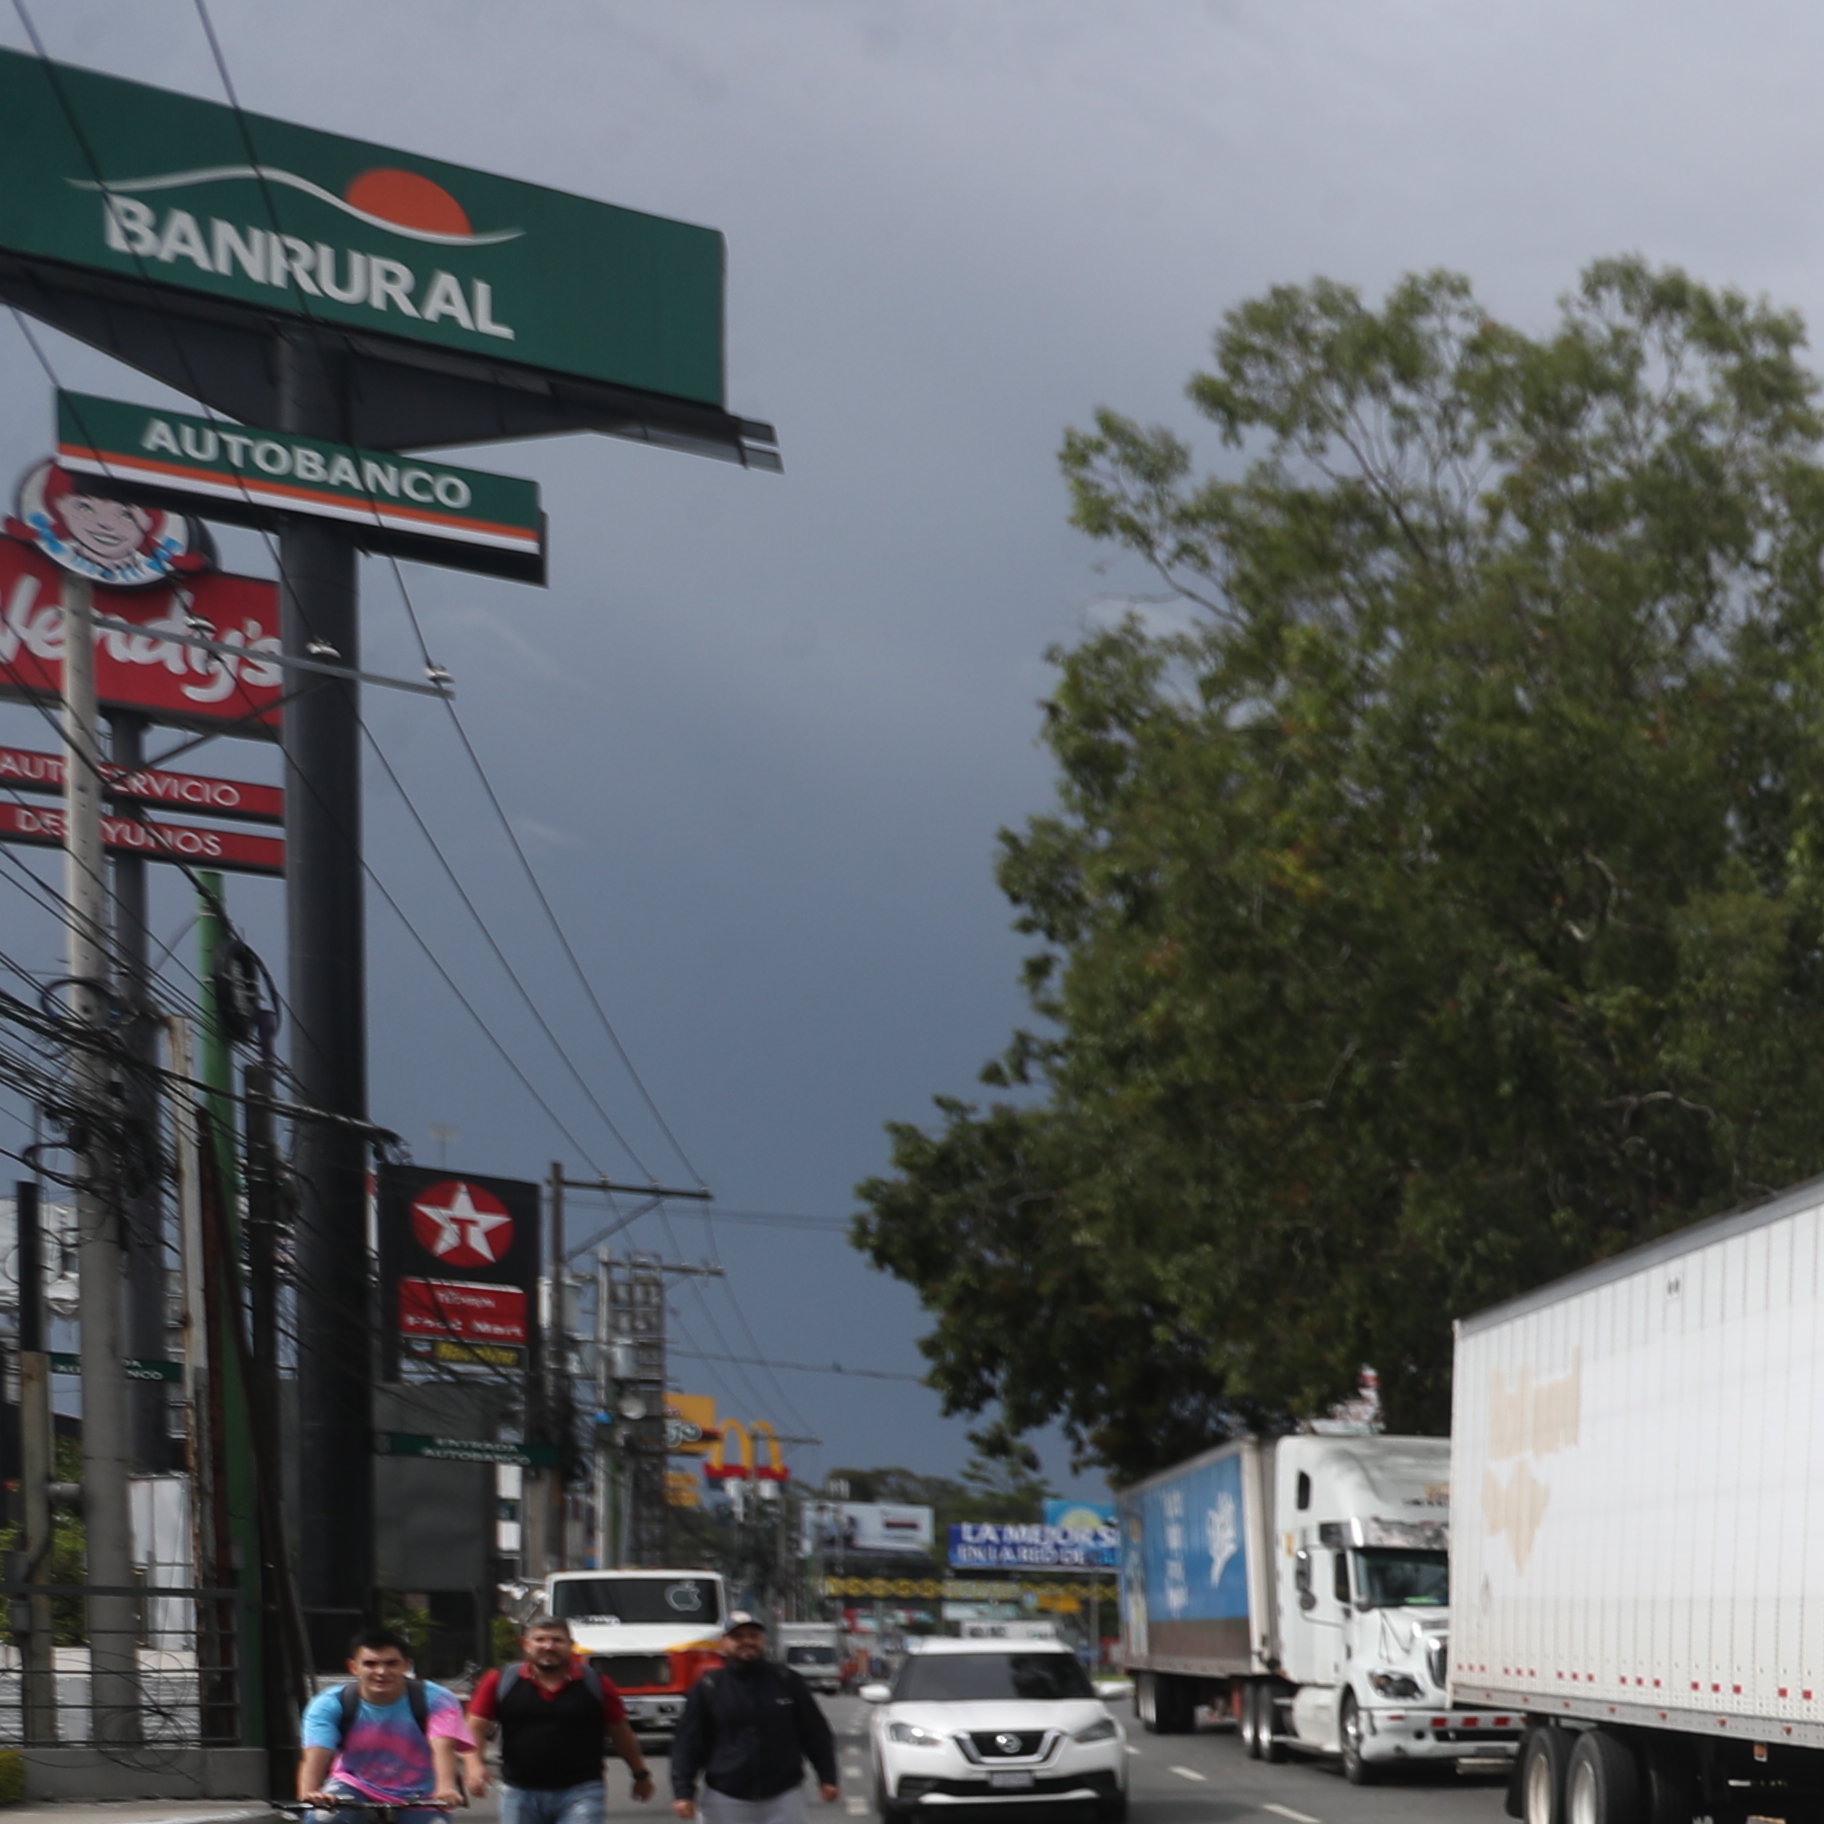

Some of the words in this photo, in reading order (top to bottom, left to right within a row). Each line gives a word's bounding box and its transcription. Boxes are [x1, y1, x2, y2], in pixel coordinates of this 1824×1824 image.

[103, 192, 515, 341] BANRURAL
[141, 418, 472, 510] AUTOBANCO
[960, 1521, 1000, 1544] LA
